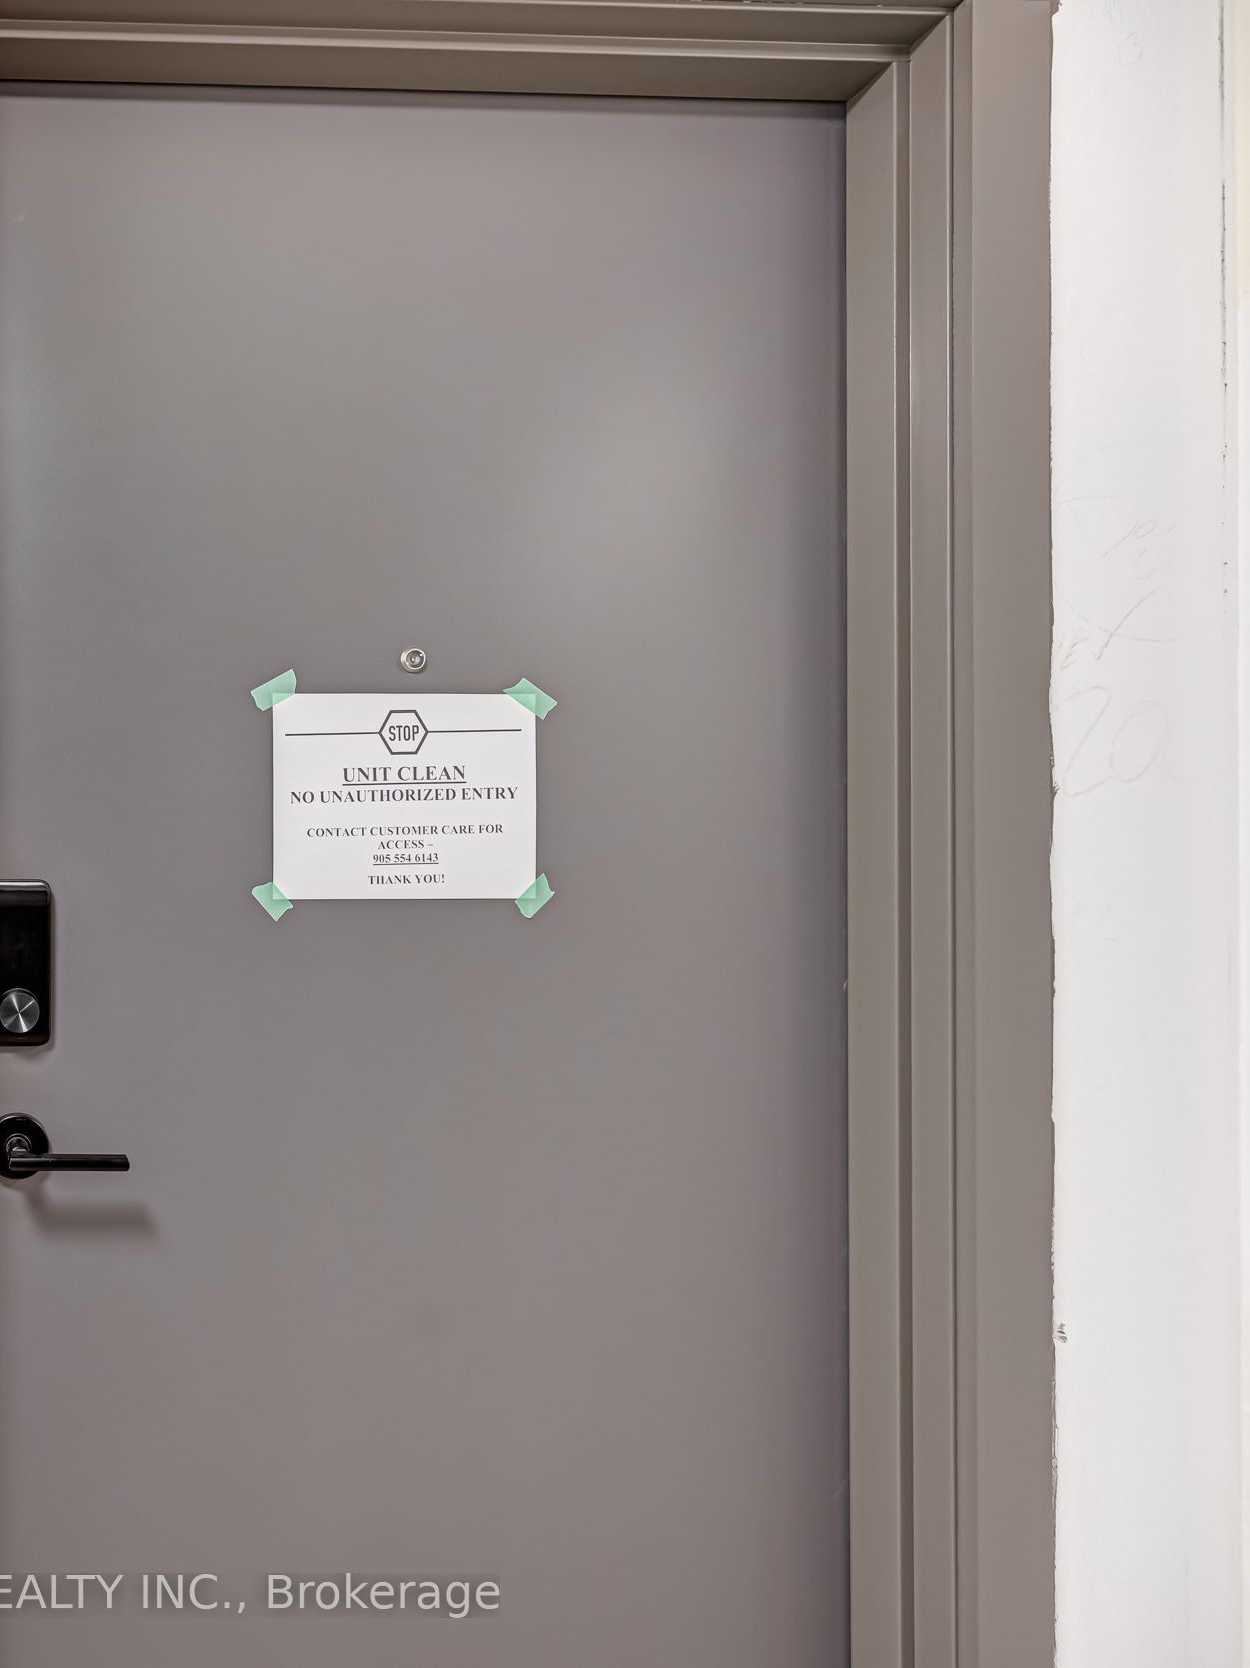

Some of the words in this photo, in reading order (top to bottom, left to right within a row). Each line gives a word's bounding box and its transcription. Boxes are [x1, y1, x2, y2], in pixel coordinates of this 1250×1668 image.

[389, 725, 419, 741] STOP
[343, 767, 391, 782] UNIT
[398, 766, 465, 781] CLEAN
[291, 791, 314, 803] NO
[321, 789, 456, 803] UNAUTHORIZED
[462, 787, 517, 800] ENTRY
[307, 827, 367, 837] CONTACT
[370, 826, 438, 836] CUSTOMER
[442, 825, 475, 834] CARE
[479, 824, 502, 833] FOR
[378, 840, 424, 849] ACCESS
[373, 854, 390, 863] 905
[394, 854, 411, 863] 554
[415, 853, 438, 863] 6143
[368, 875, 411, 884] THANK
[415, 874, 444, 883] YOU!
